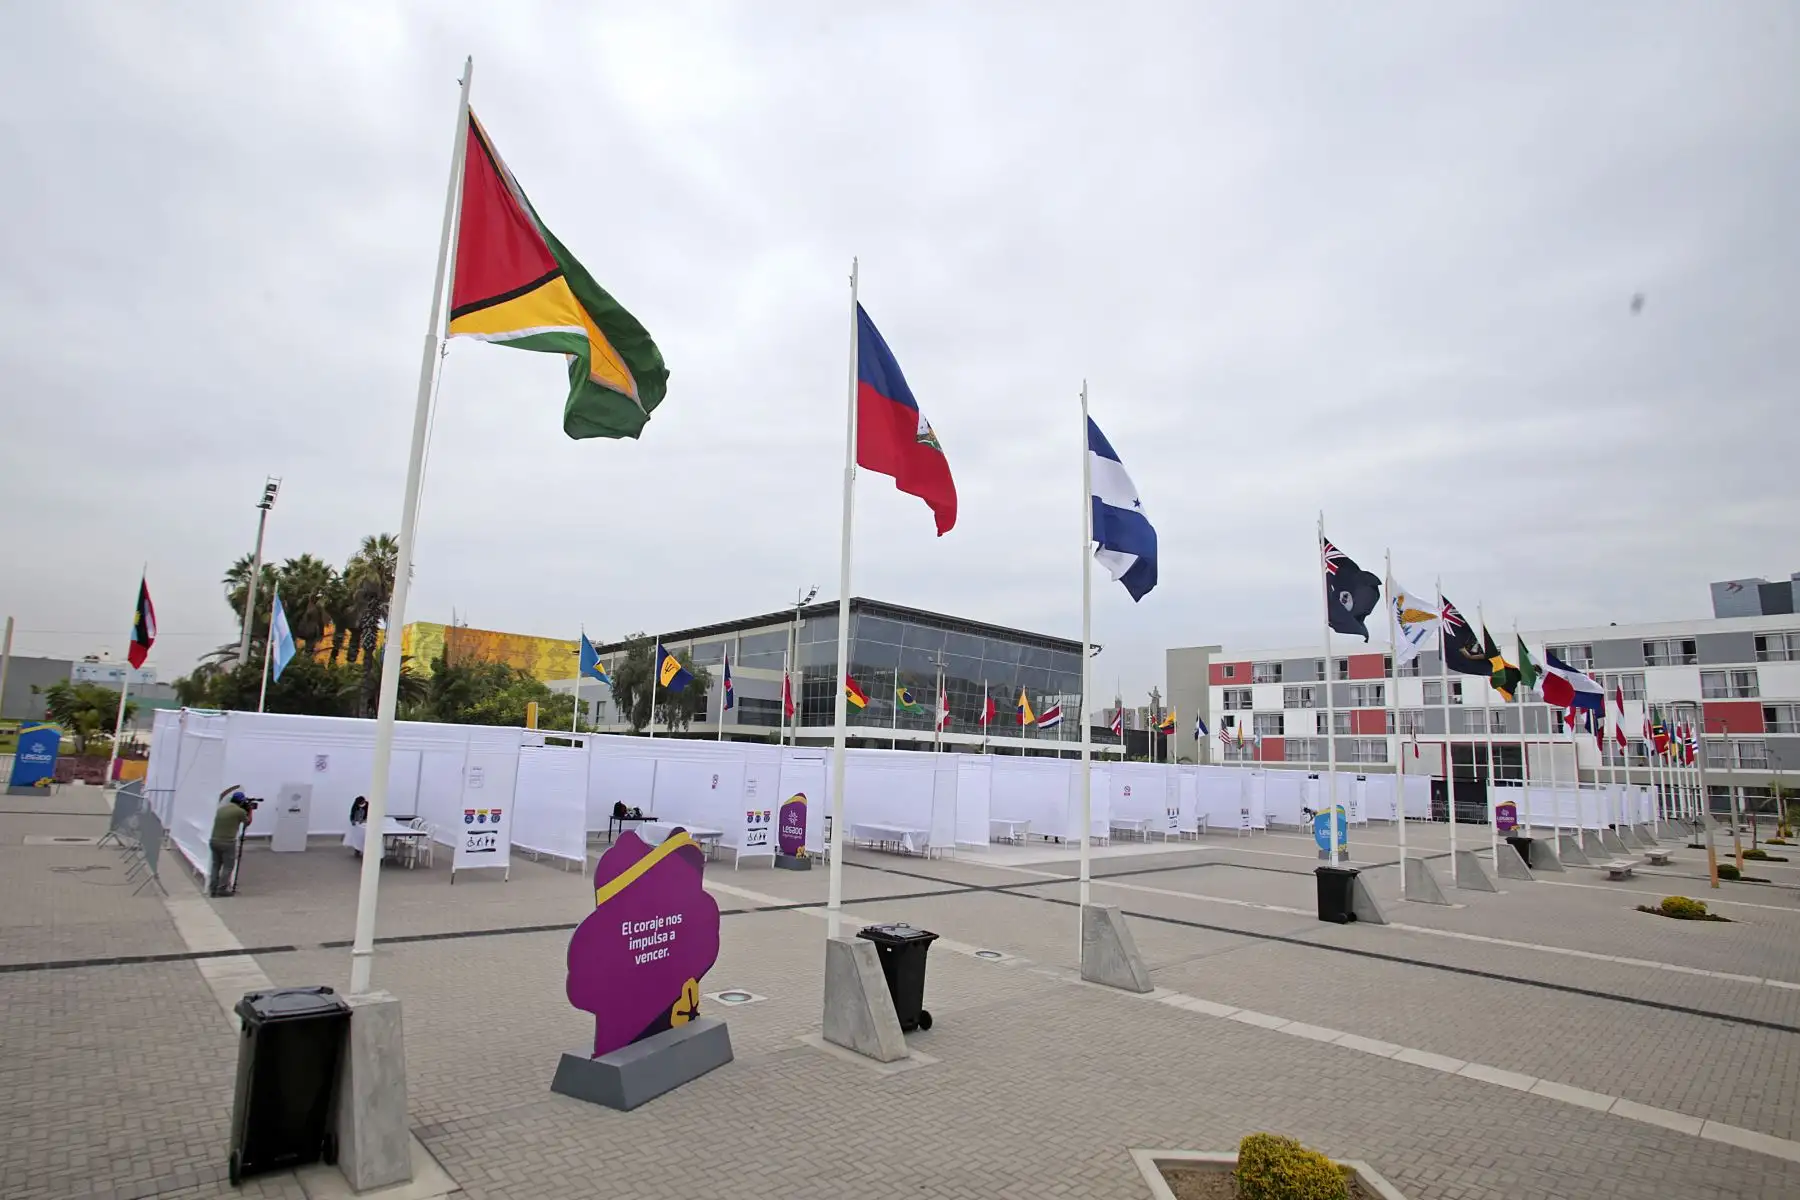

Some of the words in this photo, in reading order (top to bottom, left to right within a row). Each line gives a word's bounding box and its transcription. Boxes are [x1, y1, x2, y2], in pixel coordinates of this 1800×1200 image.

[622, 921, 632, 935] El
[634, 915, 664, 932] coraje
[665, 914, 682, 926] nos
[629, 931, 668, 950] impulsa
[670, 930, 676, 940] a
[635, 947, 670, 964] vencer.
